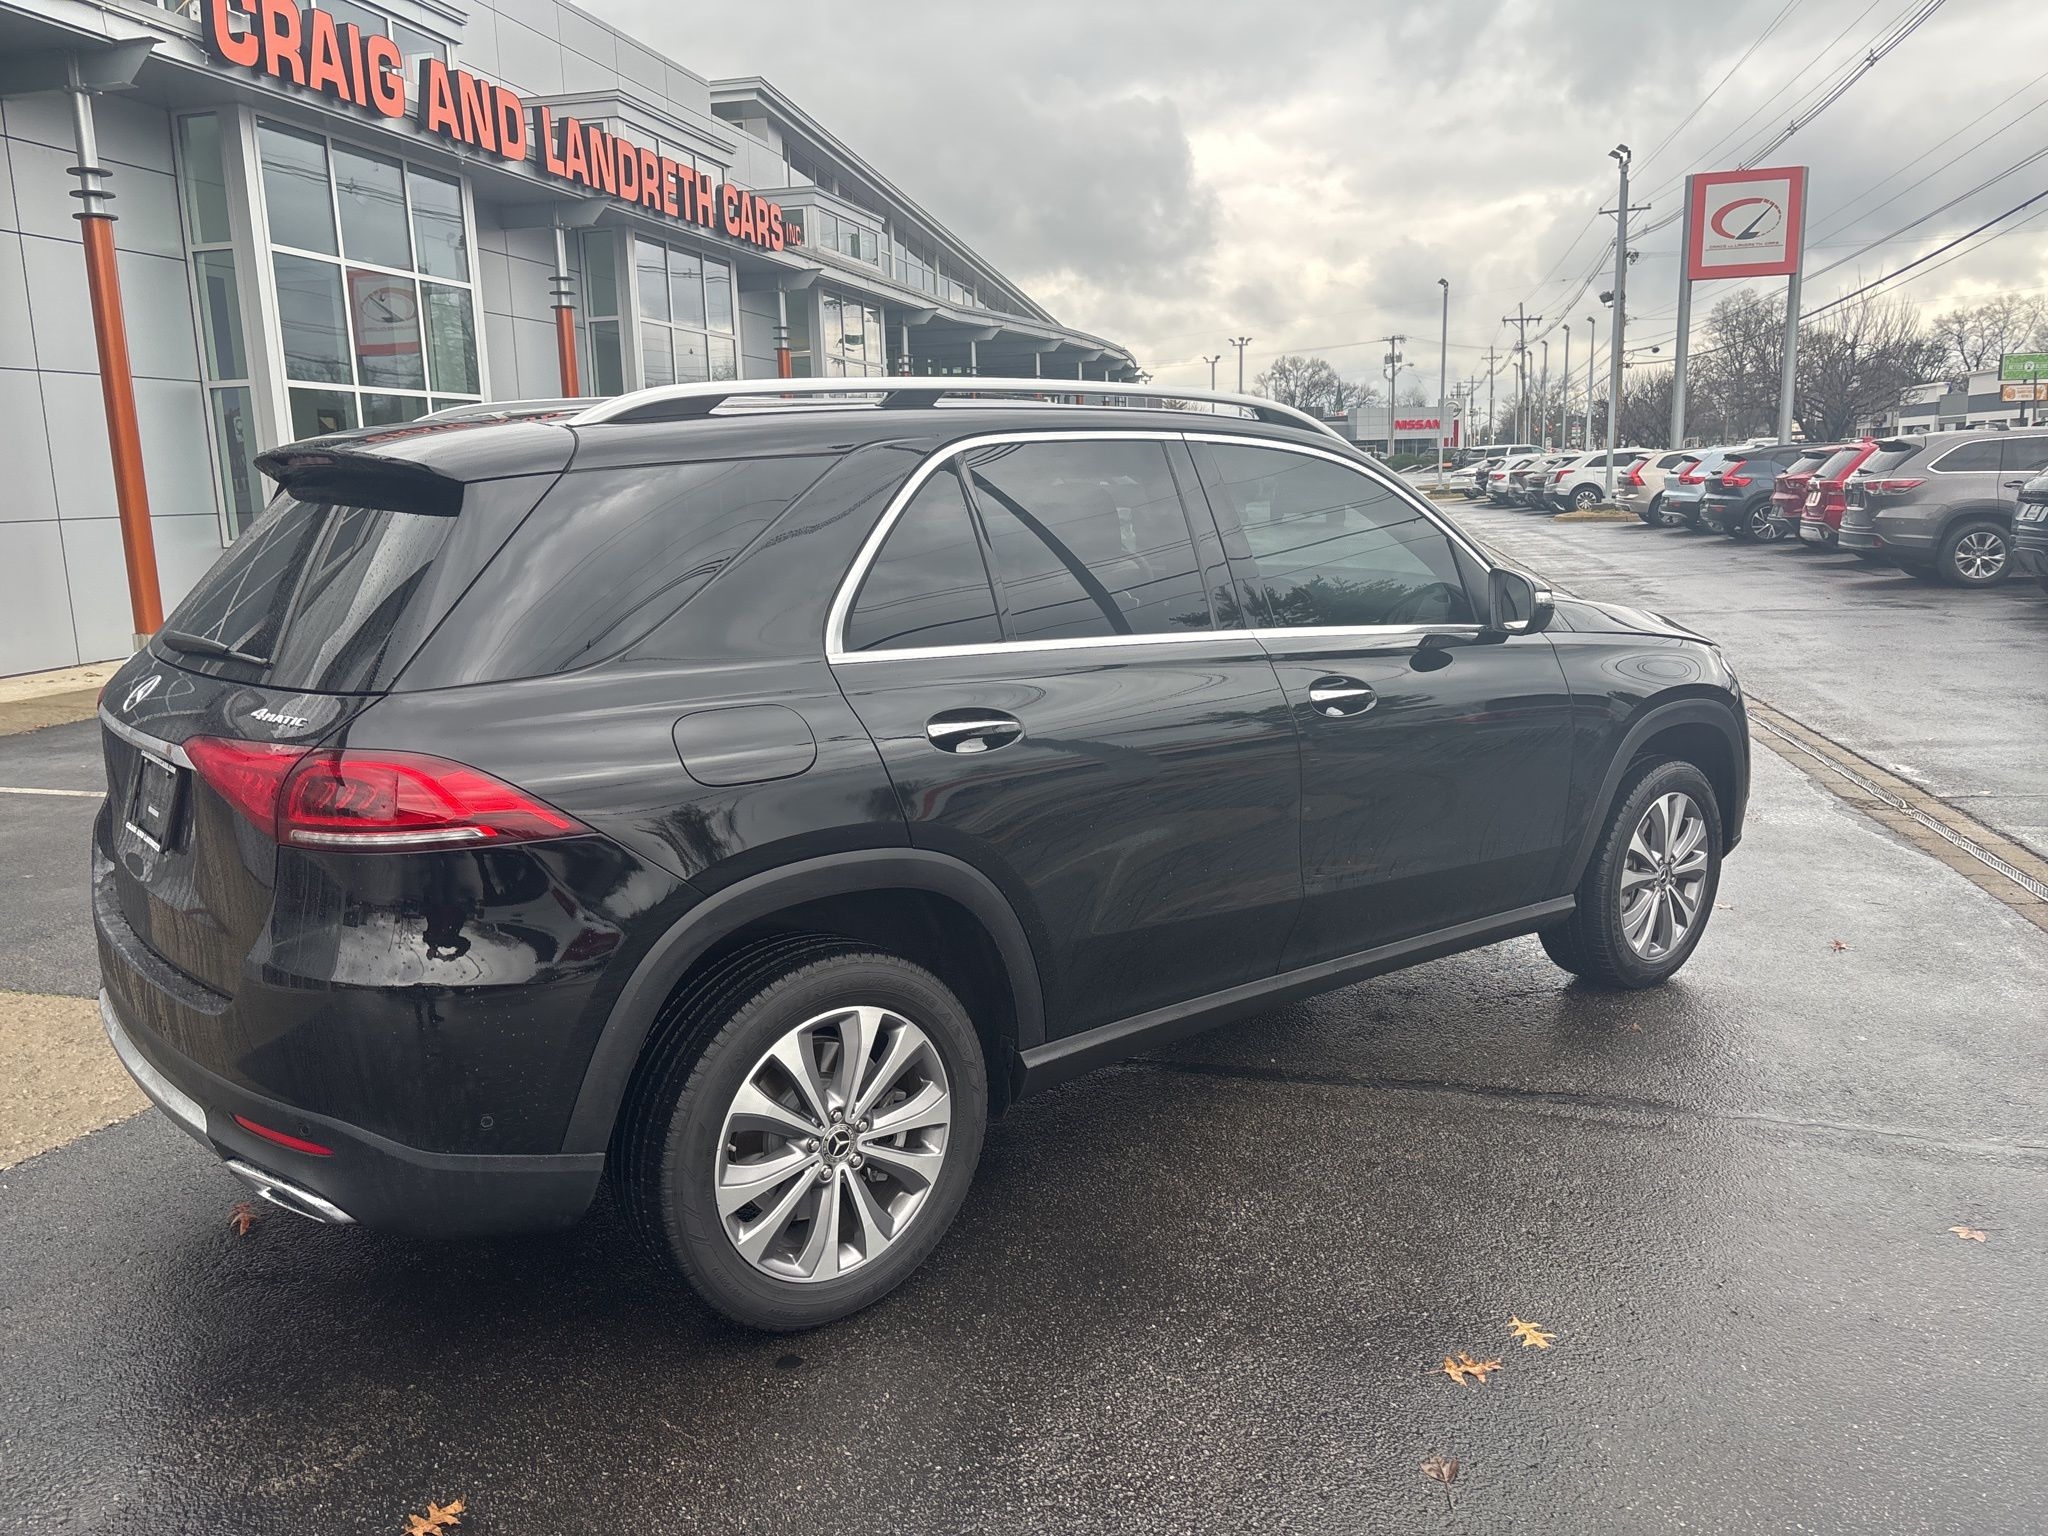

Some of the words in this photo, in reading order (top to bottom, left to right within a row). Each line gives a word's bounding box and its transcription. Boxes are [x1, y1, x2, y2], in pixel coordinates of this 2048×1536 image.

[212, 0, 405, 118] CRAIG
[428, 57, 527, 162] AND
[541, 105, 715, 229] LANDRETH
[722, 183, 785, 252] CARS
[1394, 419, 1440, 430] NISSAN
[250, 708, 308, 728] 4MATIC
